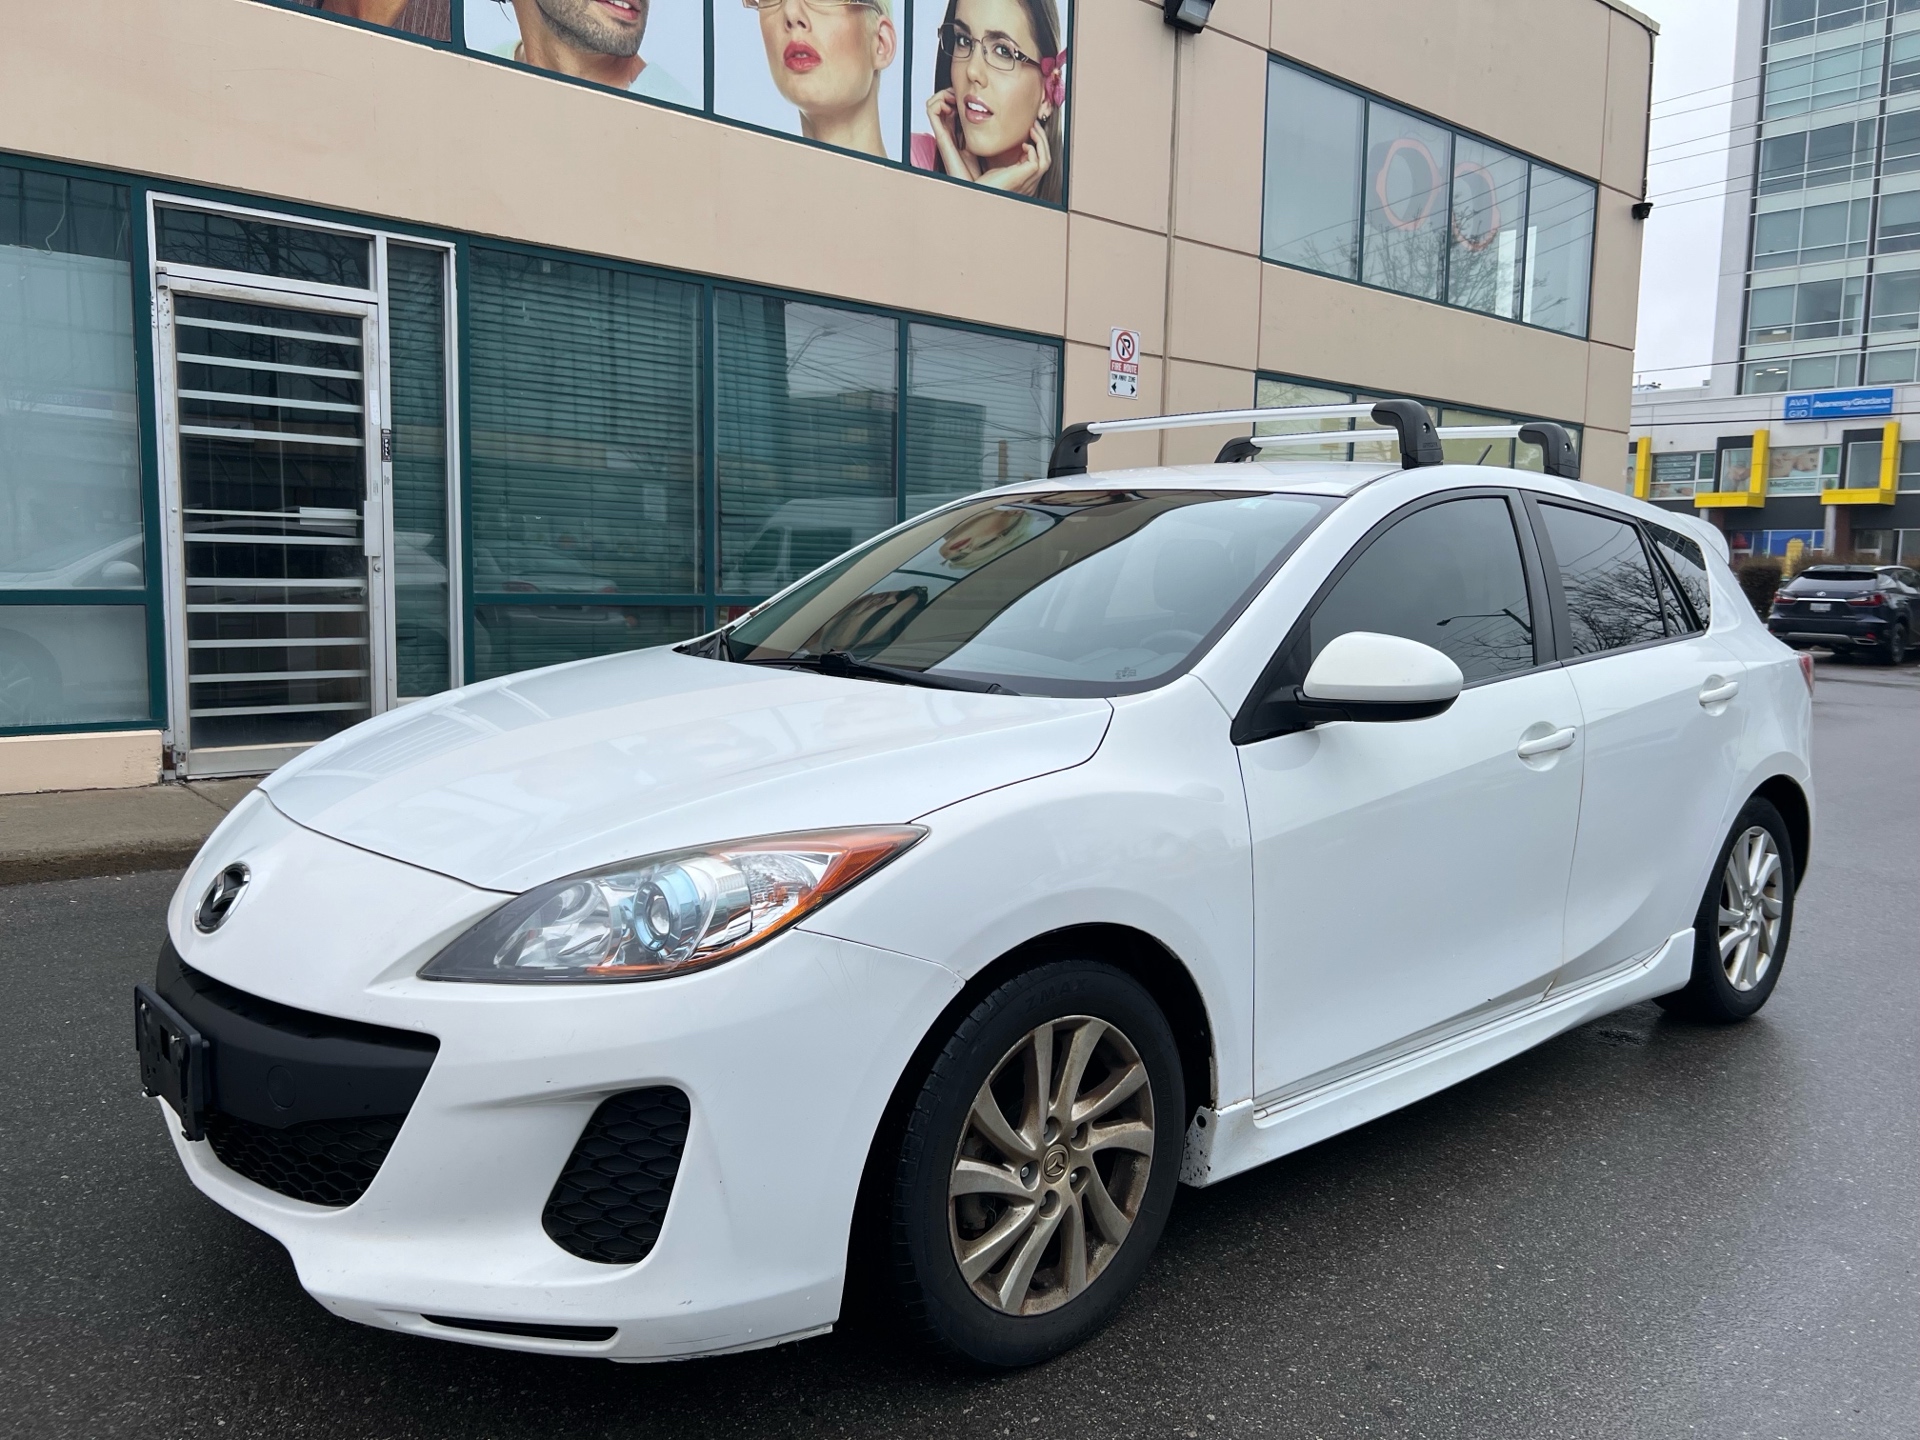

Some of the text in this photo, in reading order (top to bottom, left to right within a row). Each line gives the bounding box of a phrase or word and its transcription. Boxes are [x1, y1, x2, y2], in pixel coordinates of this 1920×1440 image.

[1112, 361, 1137, 374] FIRE ROUTE
[1118, 374, 1127, 382] AWAY
[1788, 398, 1809, 407] AVA
[1788, 409, 1808, 418] GIO
[1025, 978, 1088, 1014] ZMAX
